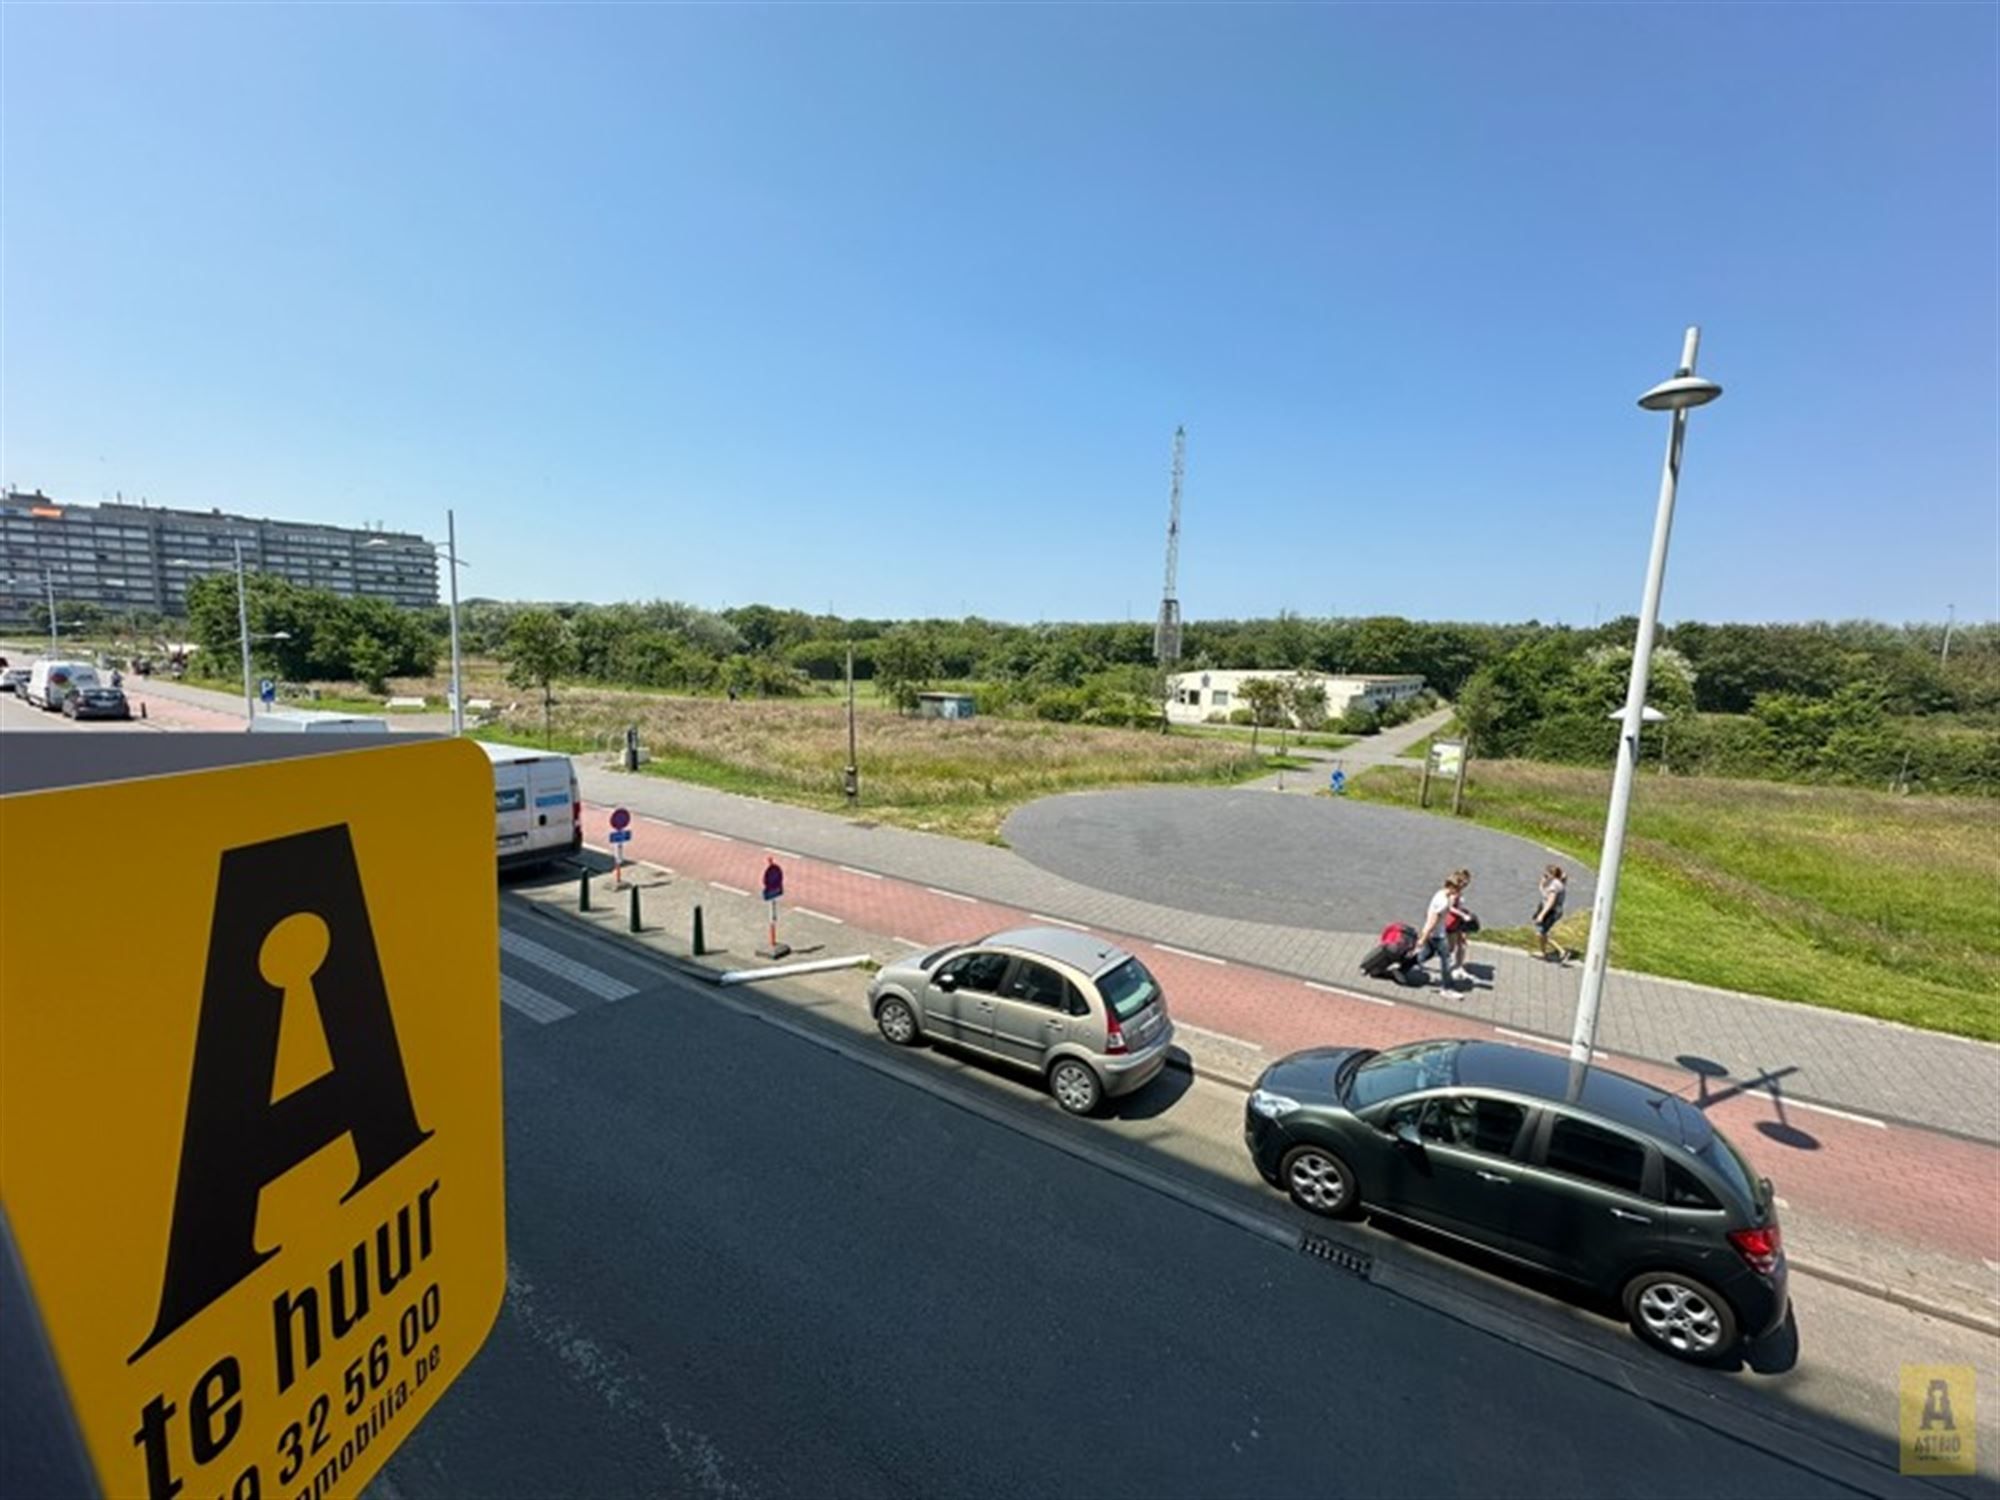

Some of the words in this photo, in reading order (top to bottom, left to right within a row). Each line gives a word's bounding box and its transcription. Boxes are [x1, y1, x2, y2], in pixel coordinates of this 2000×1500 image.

[261, 680, 273, 695] P
[127, 822, 436, 1366] A
[133, 1355, 243, 1500] te
[273, 1179, 441, 1396] huur
[276, 1393, 331, 1486] 32
[343, 1334, 390, 1416] 56
[400, 1282, 440, 1358] 00
[294, 1343, 441, 1500] mobilia.be
